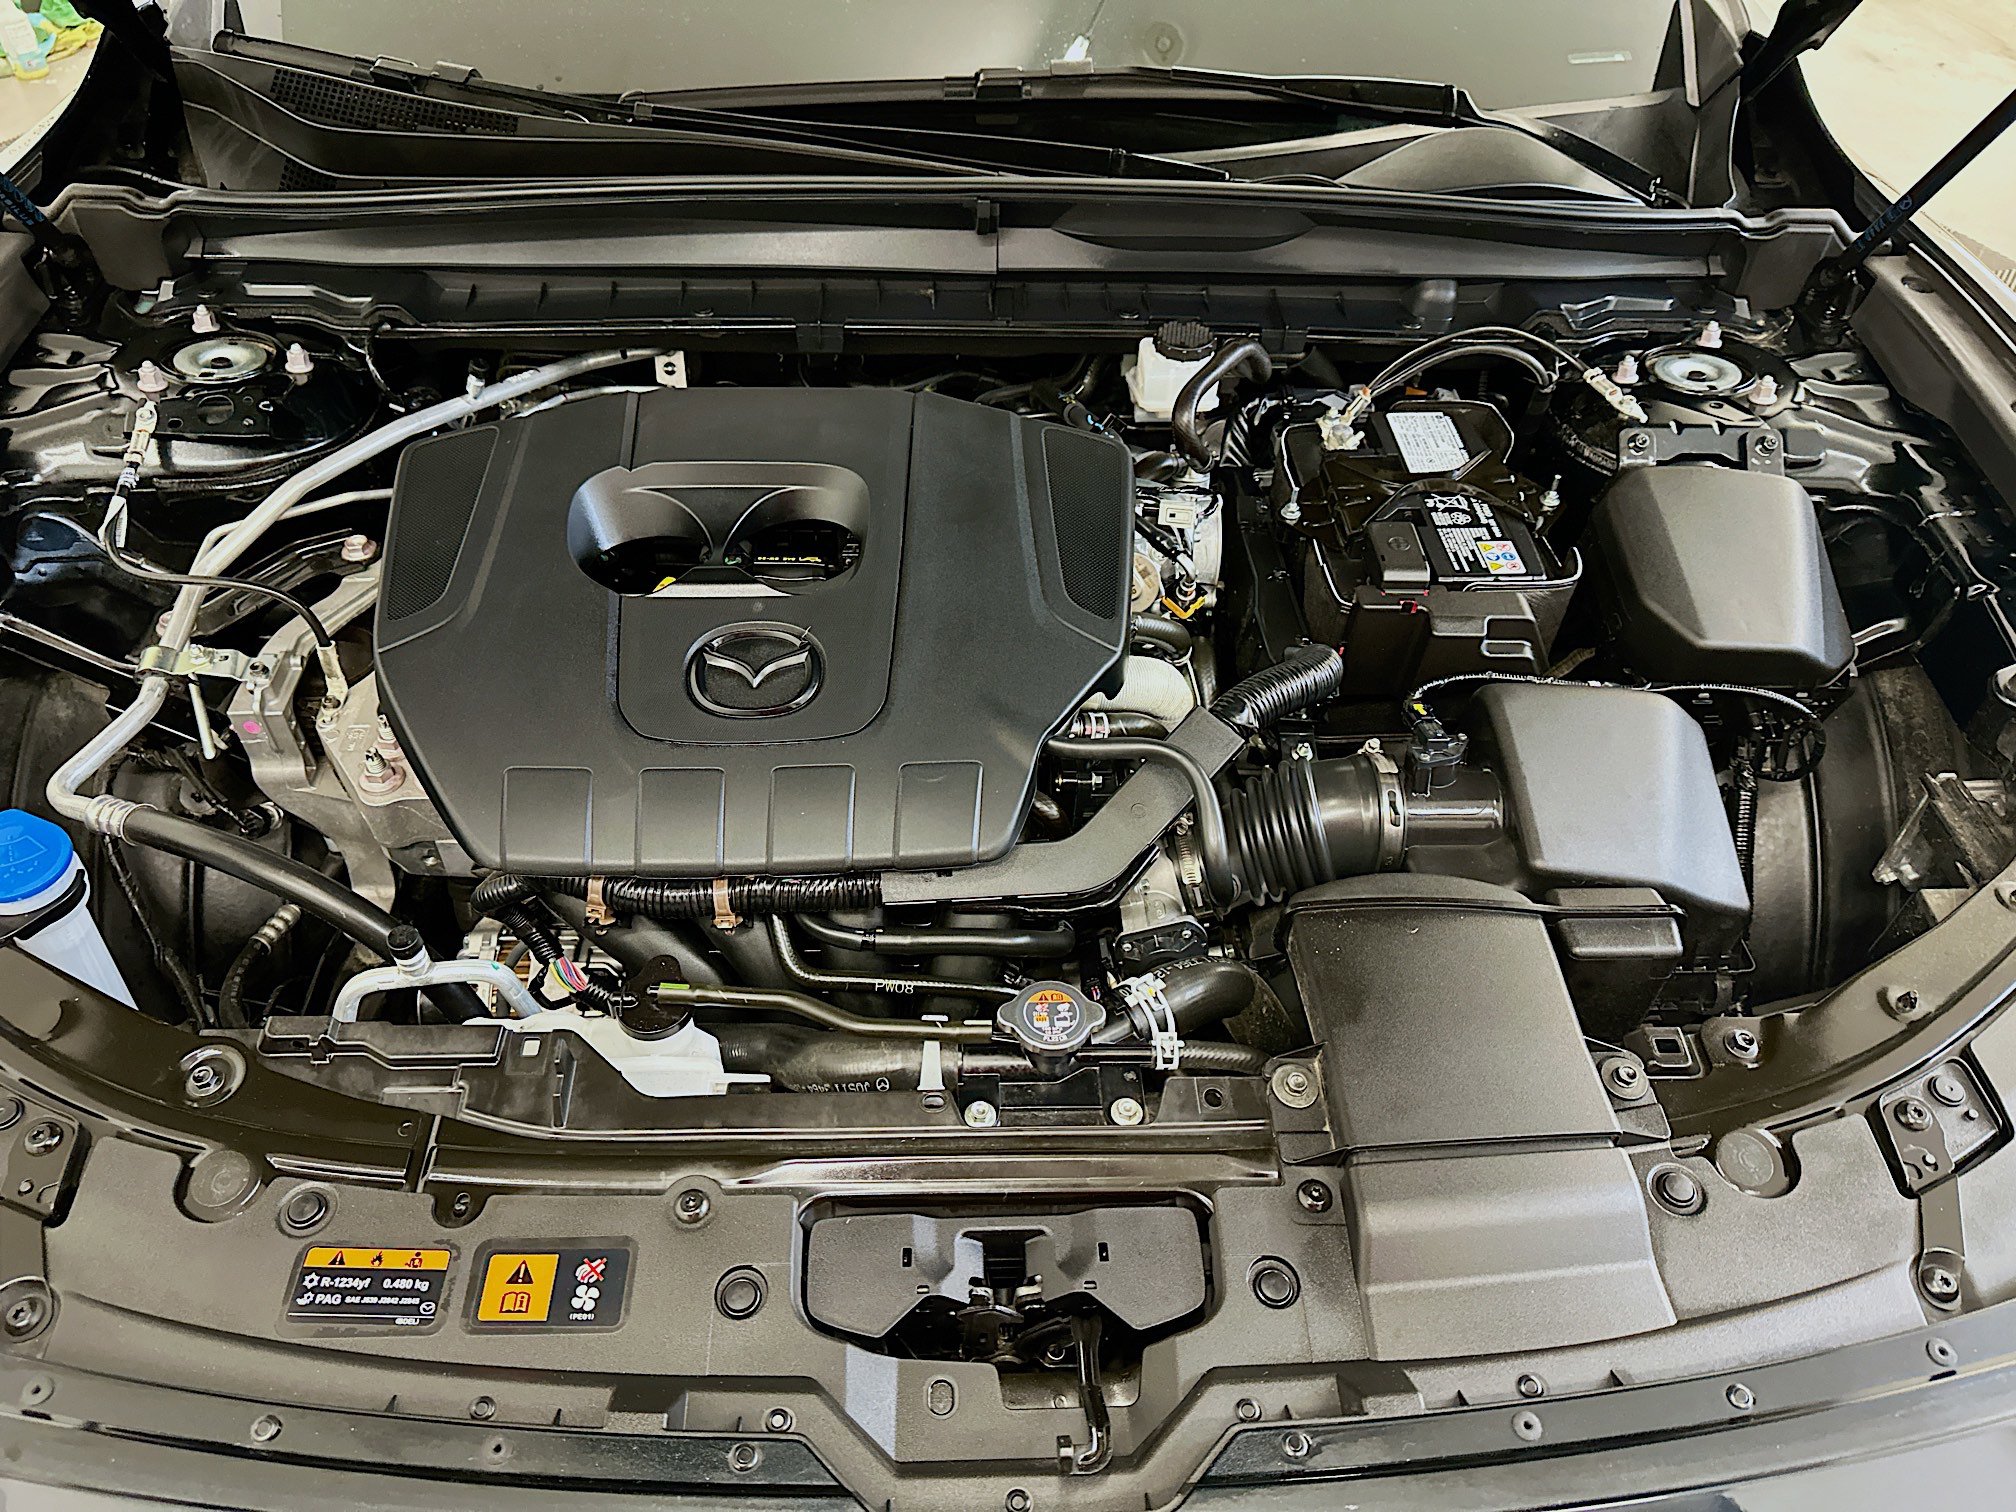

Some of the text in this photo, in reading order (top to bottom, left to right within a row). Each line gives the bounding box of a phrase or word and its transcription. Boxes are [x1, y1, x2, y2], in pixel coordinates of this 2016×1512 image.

[875, 980, 914, 994] PW08
[320, 1276, 430, 1292] R-1234yf 0.480 kg
[315, 1293, 342, 1305] PAG
[344, 1295, 361, 1304] SAE
